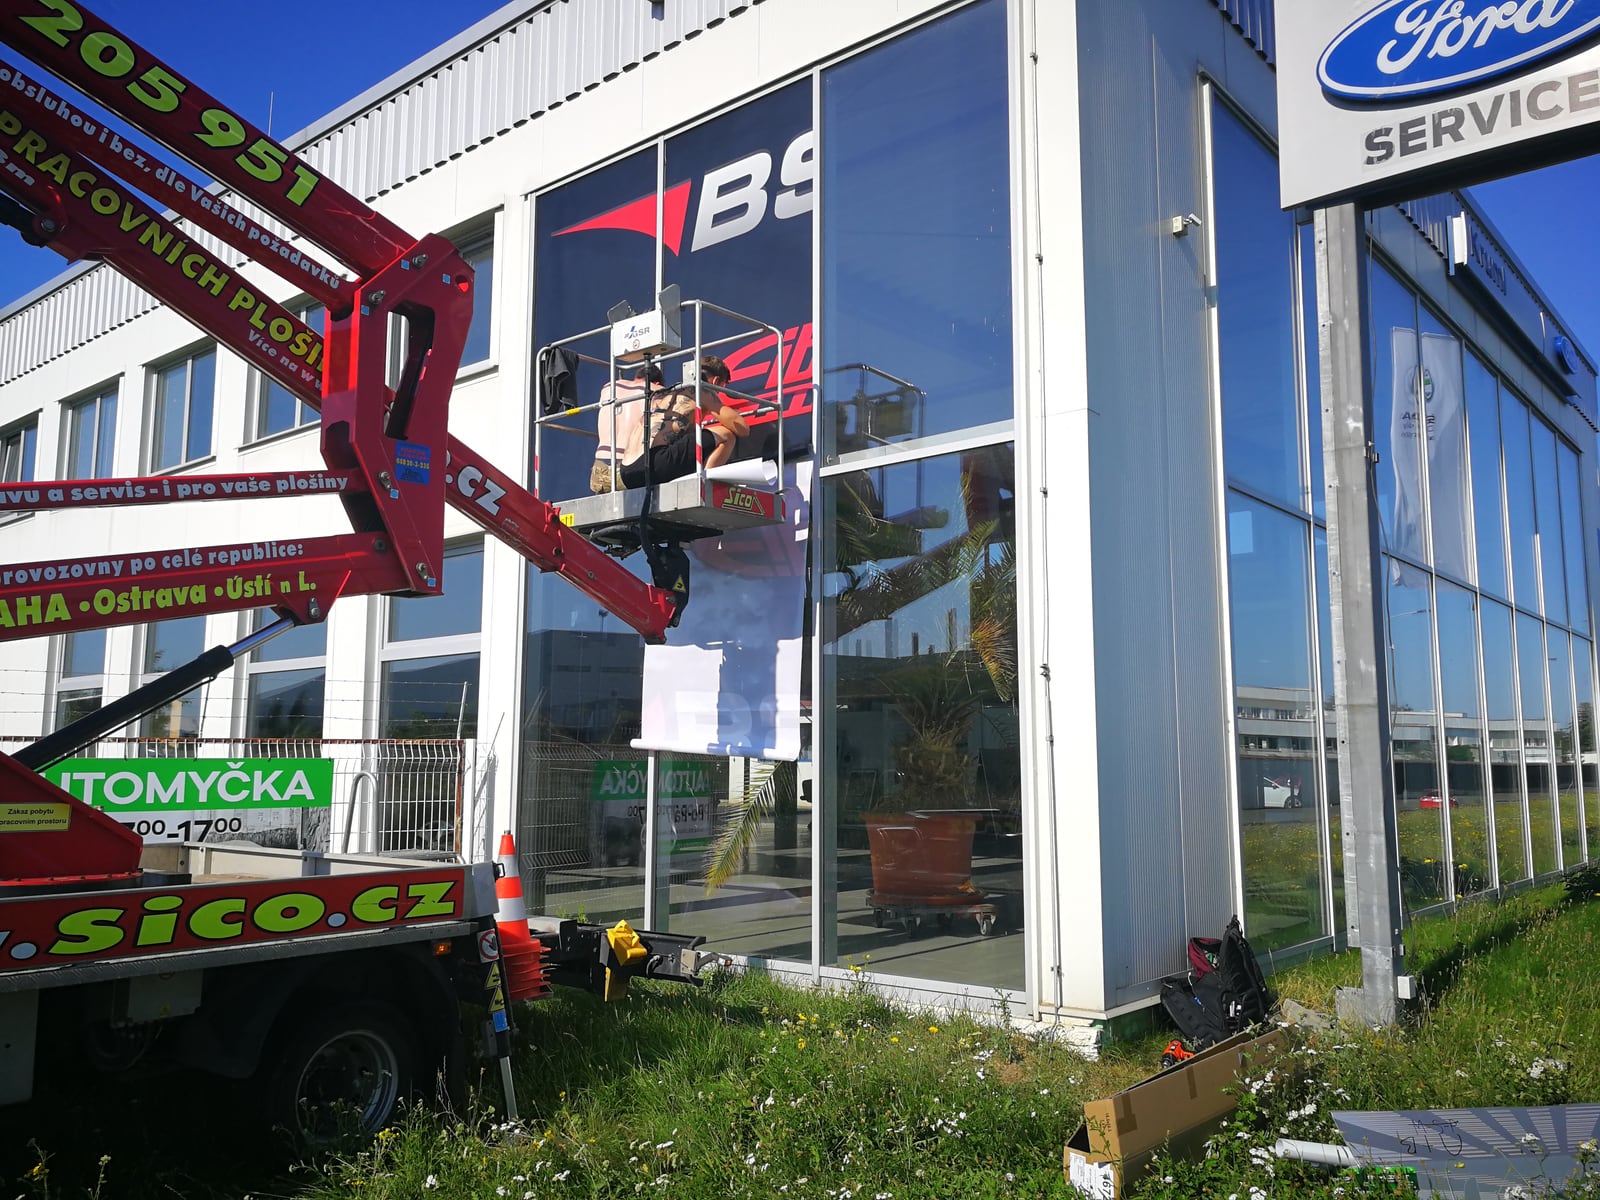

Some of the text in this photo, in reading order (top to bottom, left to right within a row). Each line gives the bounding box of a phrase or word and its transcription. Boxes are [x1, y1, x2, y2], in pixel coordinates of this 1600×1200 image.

[1376, 0, 1573, 75] Ford
[18, 0, 321, 208] 205 951
[1364, 69, 1600, 166] SERVICE
[0, 68, 341, 290] obsluhou i bez, dle Vašich požadavků
[0, 109, 323, 373] PRACOVNÍCH PLOŠI
[248, 329, 278, 358] Více
[279, 355, 299, 373] na
[47, 487, 64, 502] a
[176, 482, 217, 499] pro
[220, 476, 272, 494] vaše
[276, 474, 348, 493] plošiny
[446, 449, 507, 517] .cz
[0, 541, 304, 586] rovozovny po celé republice:
[93, 584, 208, 616] Ostrava
[225, 573, 272, 600] Ústí
[279, 580, 291, 594] n
[298, 570, 318, 592] L.
[7, 807, 55, 816] Zákaz pobytu
[37, 817, 67, 826] prostoru
[0, 881, 456, 960] .sico.cz
